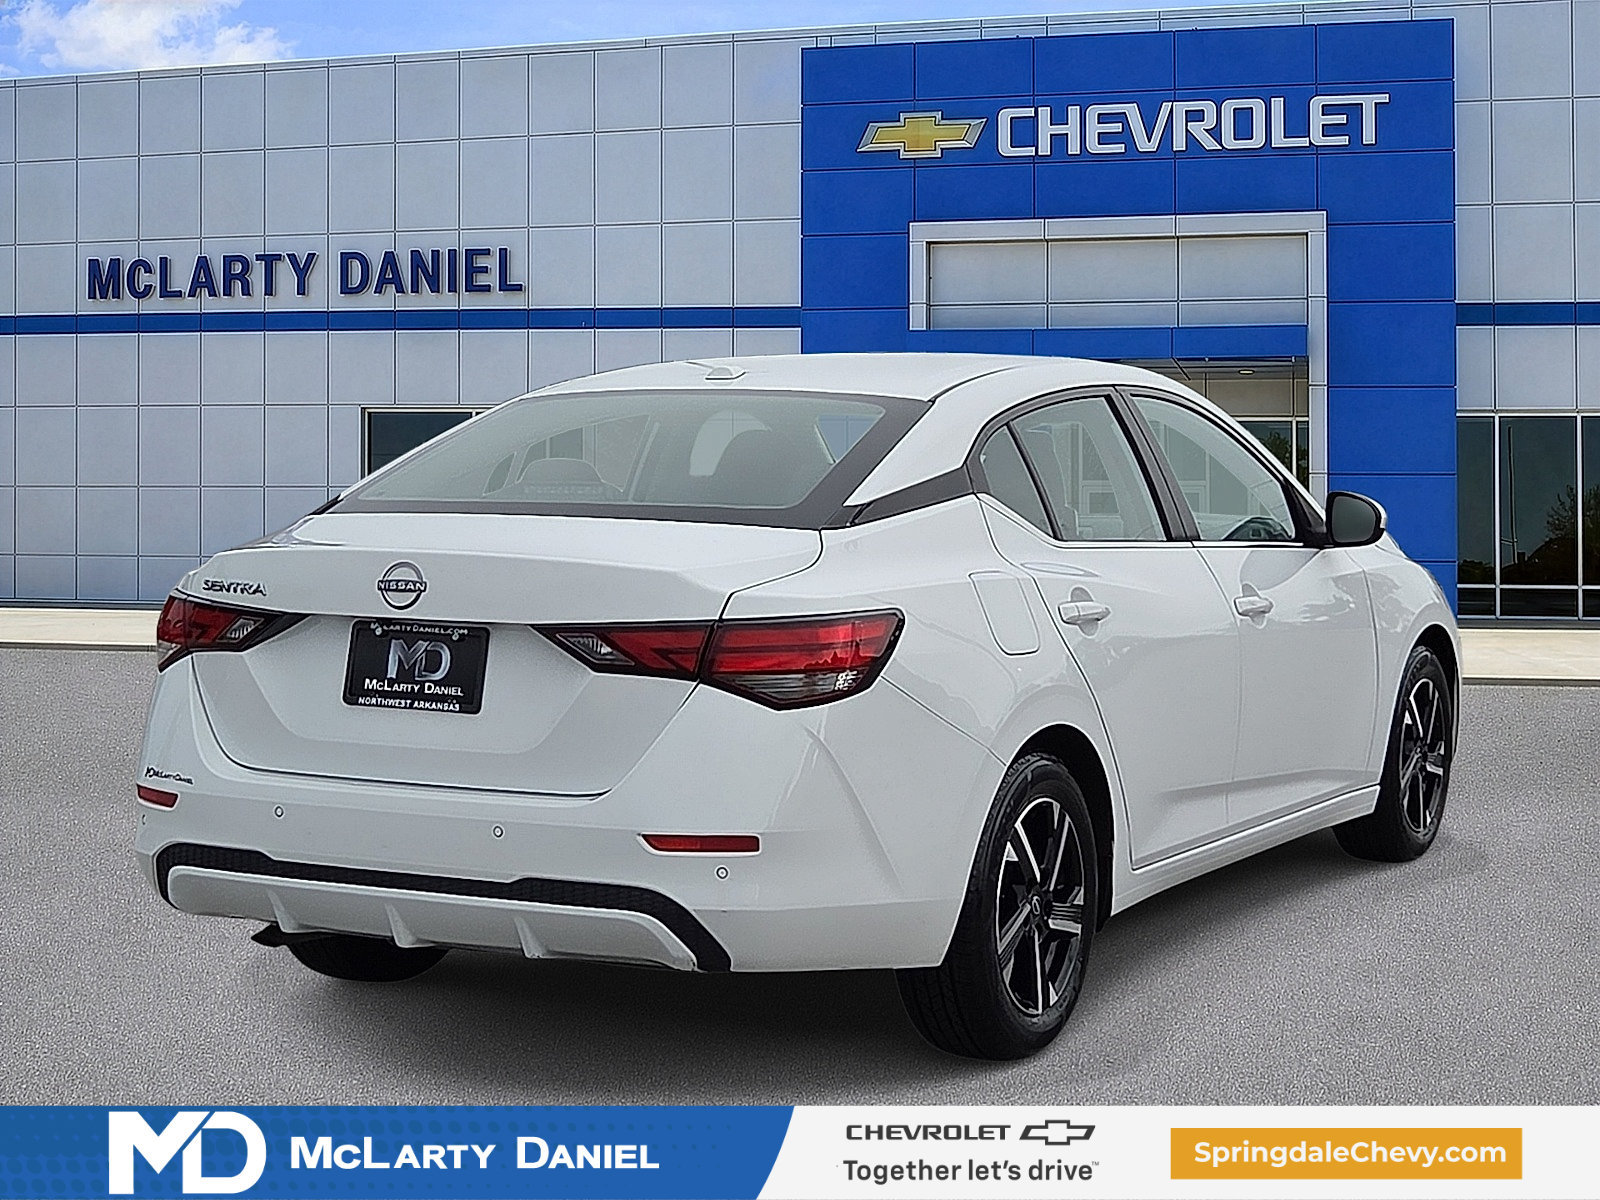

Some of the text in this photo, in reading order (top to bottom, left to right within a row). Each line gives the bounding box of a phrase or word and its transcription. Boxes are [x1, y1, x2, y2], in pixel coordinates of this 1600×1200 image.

[997, 93, 1390, 157] CHEVROLET
[87, 247, 524, 300] MCLARTY DANIEL
[202, 579, 267, 597] SENTRA
[377, 580, 428, 593] NISSAN
[386, 638, 451, 681] MD
[423, 682, 464, 697] DANIEL
[358, 696, 460, 712] NORTHWEST ARKANSAS
